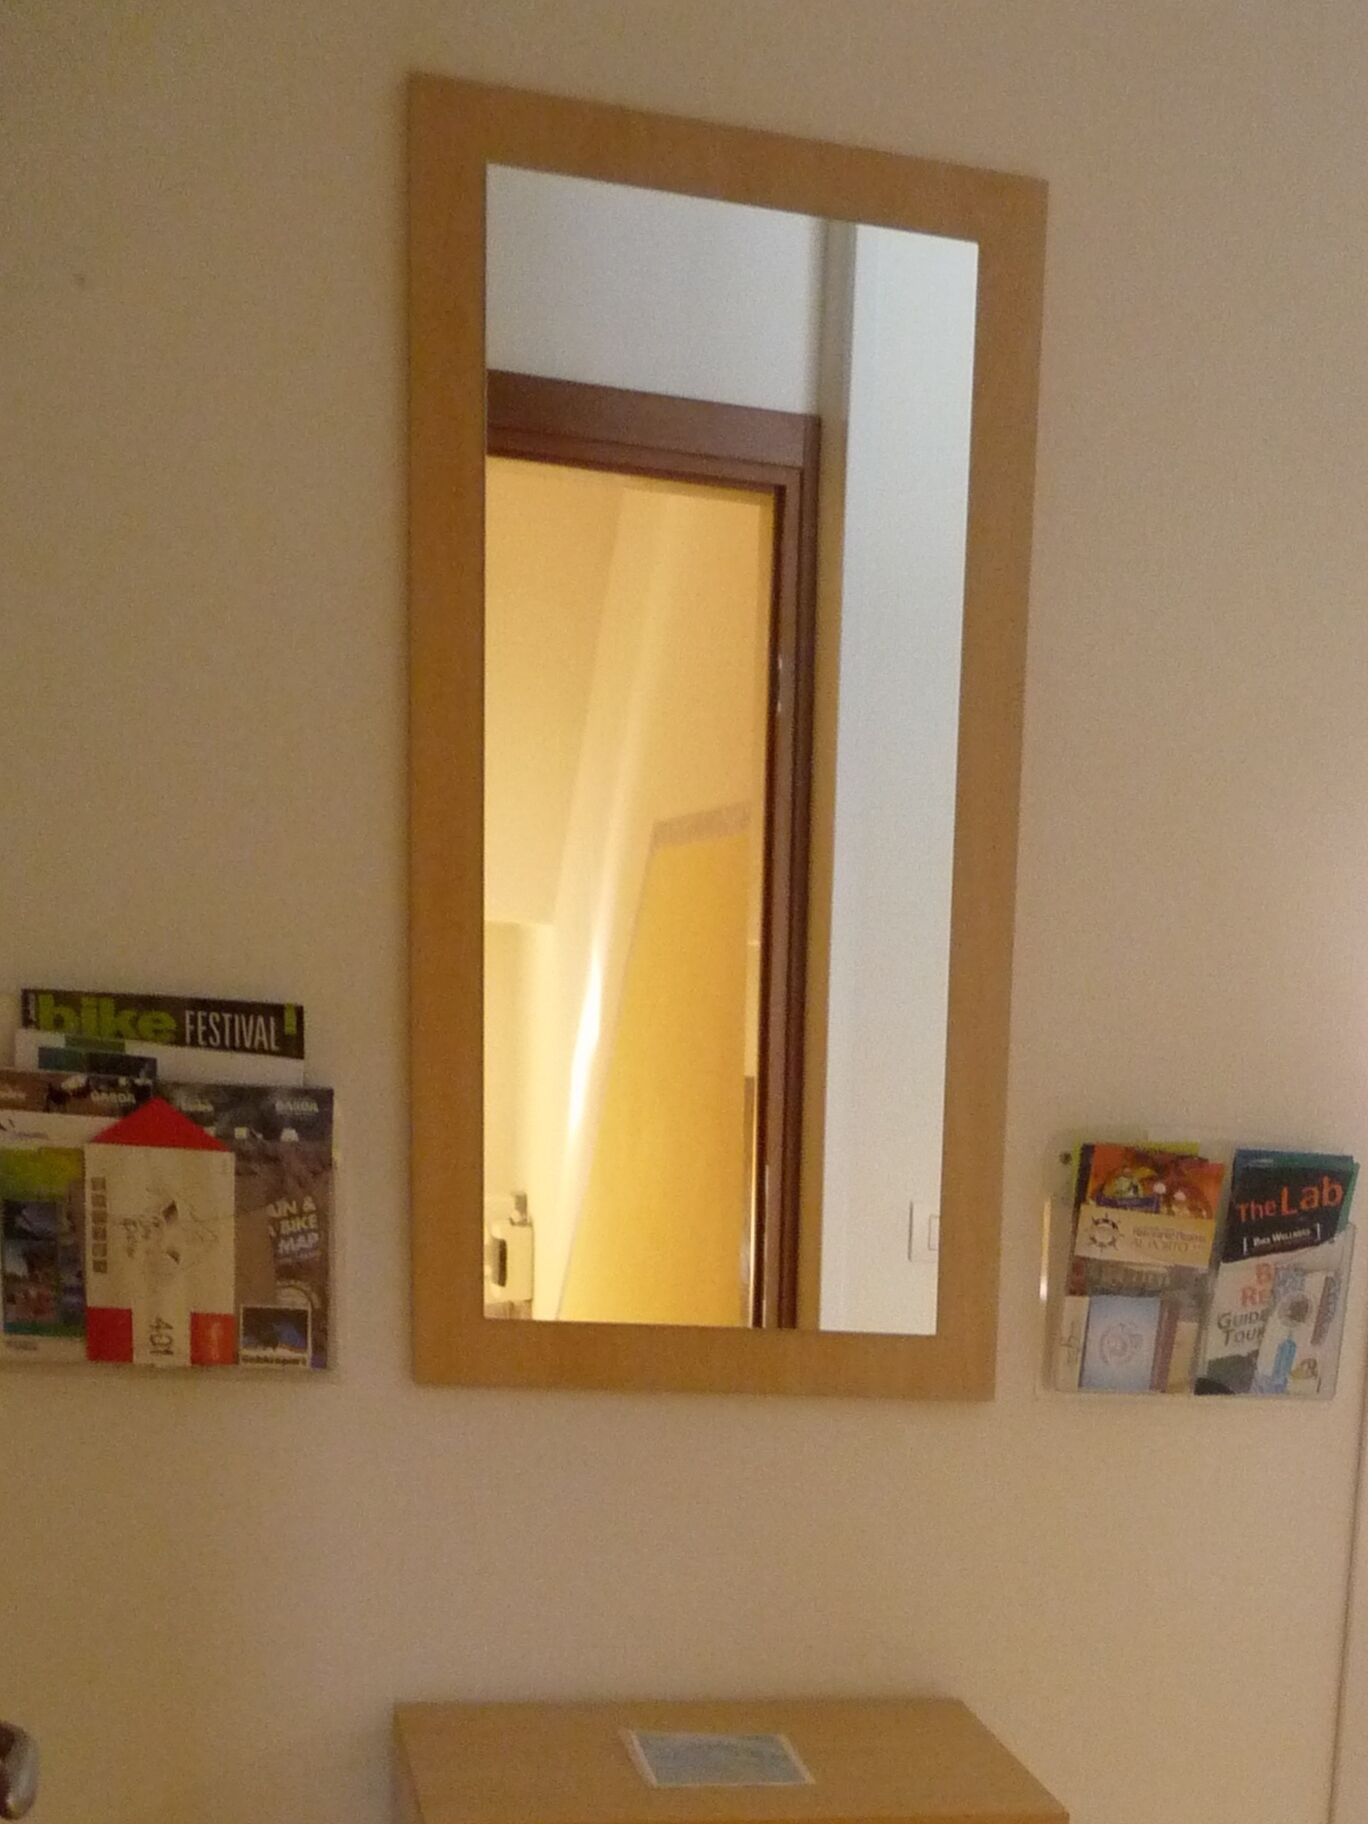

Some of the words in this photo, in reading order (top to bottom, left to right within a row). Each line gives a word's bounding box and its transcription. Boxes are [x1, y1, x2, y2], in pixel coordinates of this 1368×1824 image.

[38, 995, 177, 1042] bike
[185, 1010, 280, 1051] FESTIVAL
[1238, 1199, 1276, 1223] The
[1280, 1175, 1345, 1216] Lab
